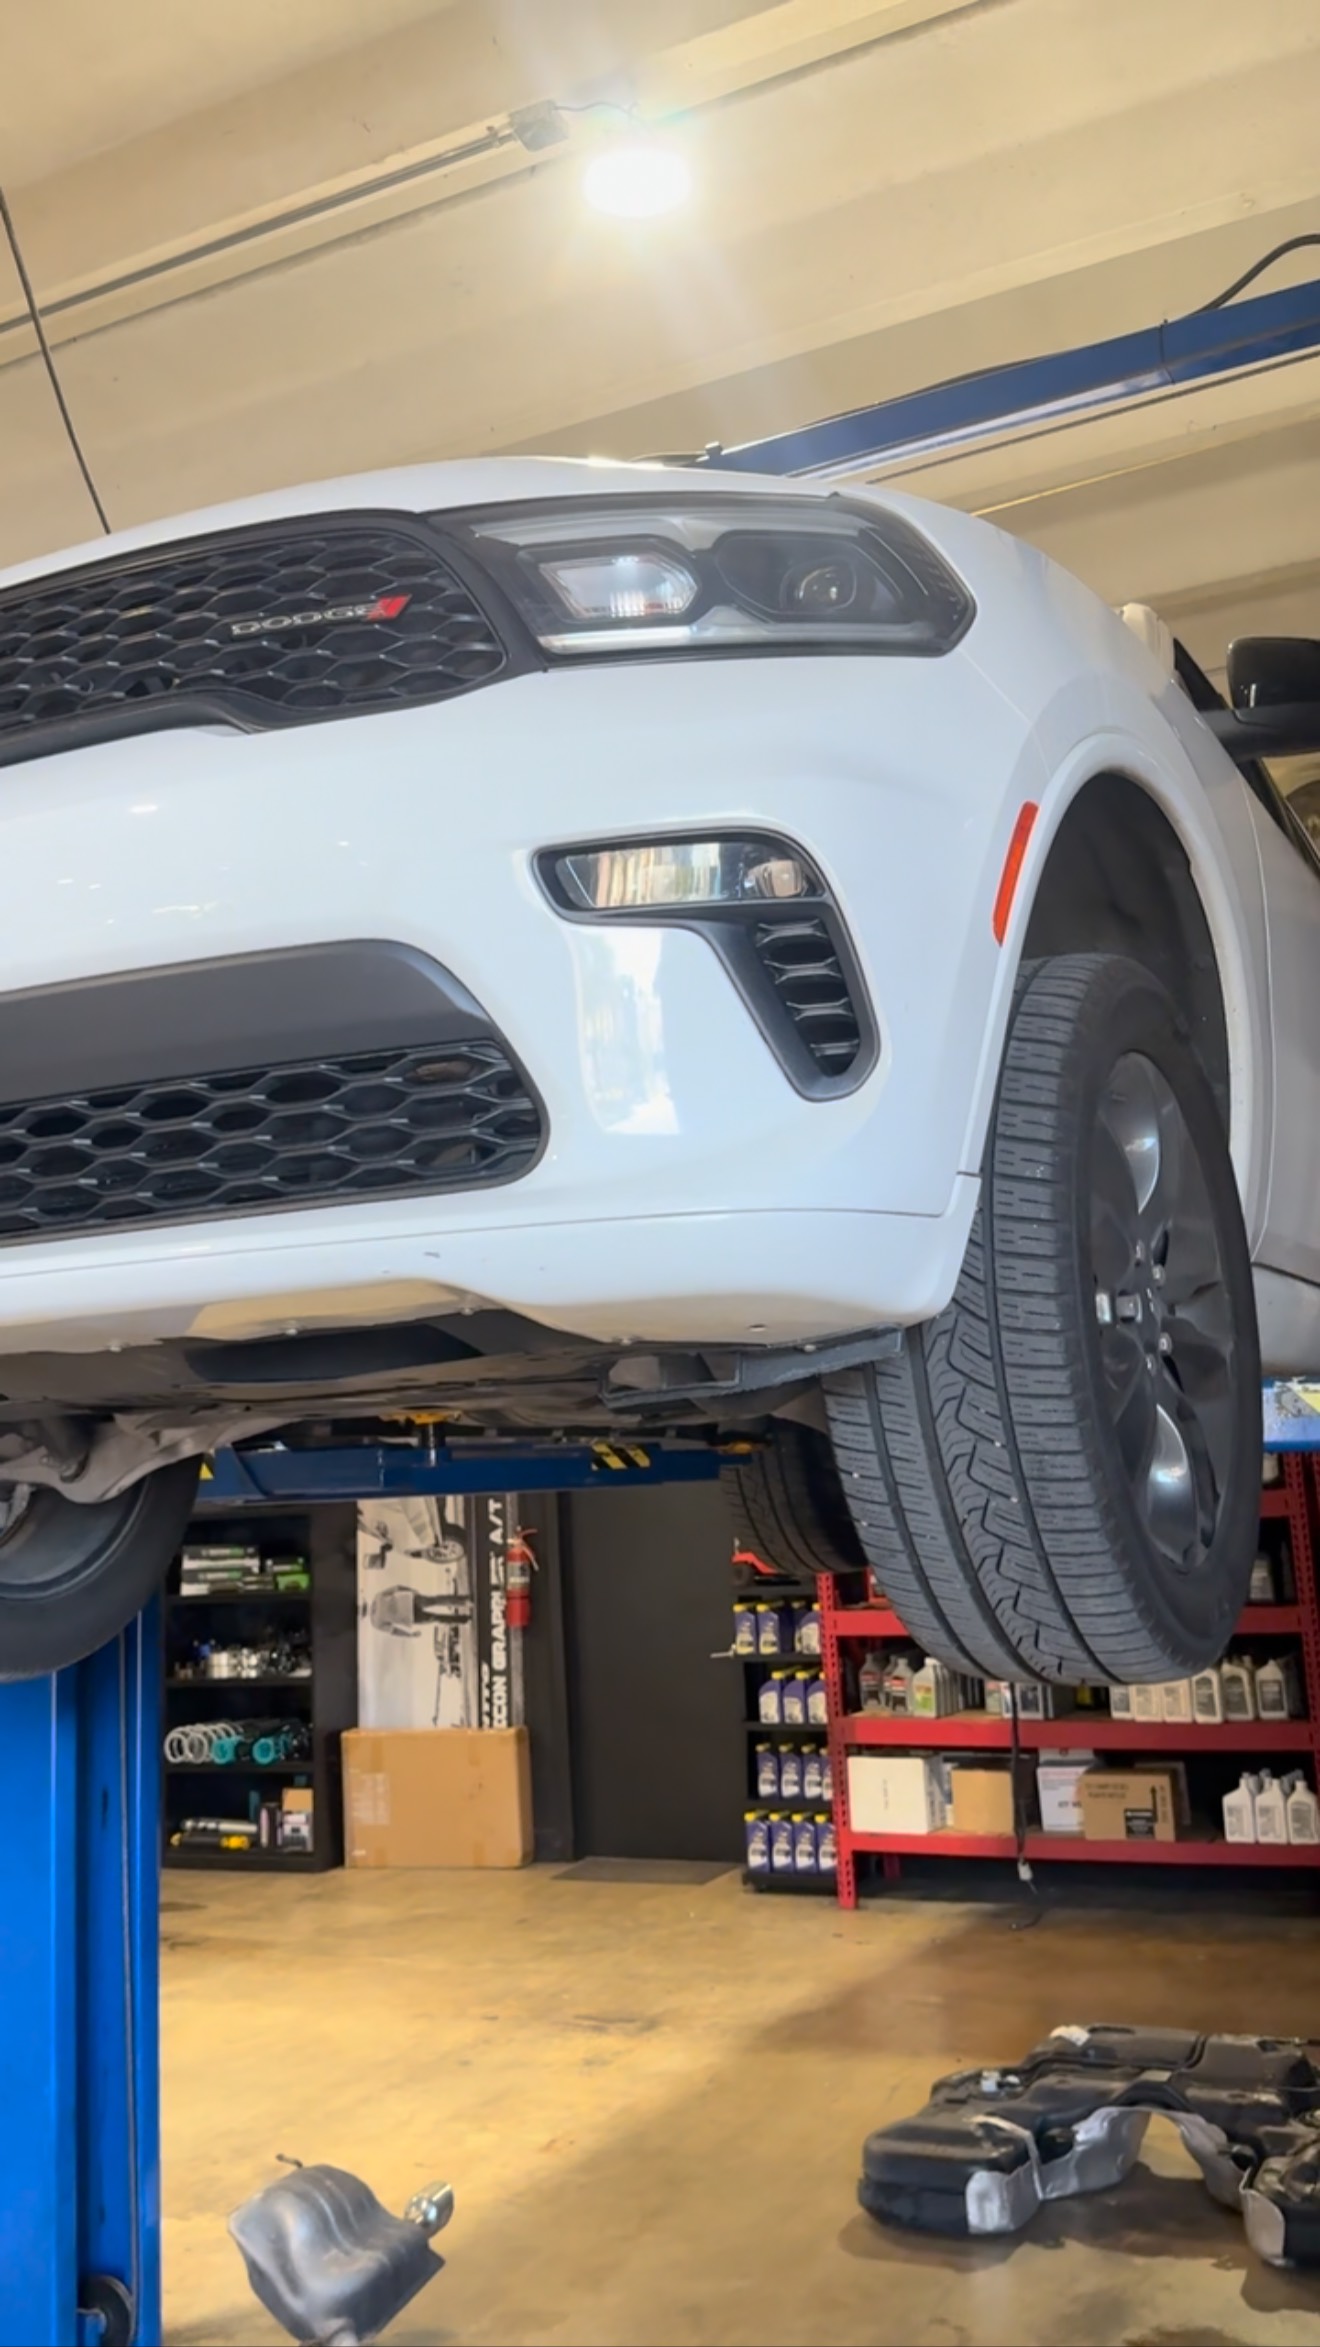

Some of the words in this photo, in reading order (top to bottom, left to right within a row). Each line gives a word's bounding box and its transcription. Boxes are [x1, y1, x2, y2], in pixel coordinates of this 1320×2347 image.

[231, 603, 377, 635] DODGE
[488, 1498, 503, 1545] A/T
[481, 1661, 490, 1728] ITTO
